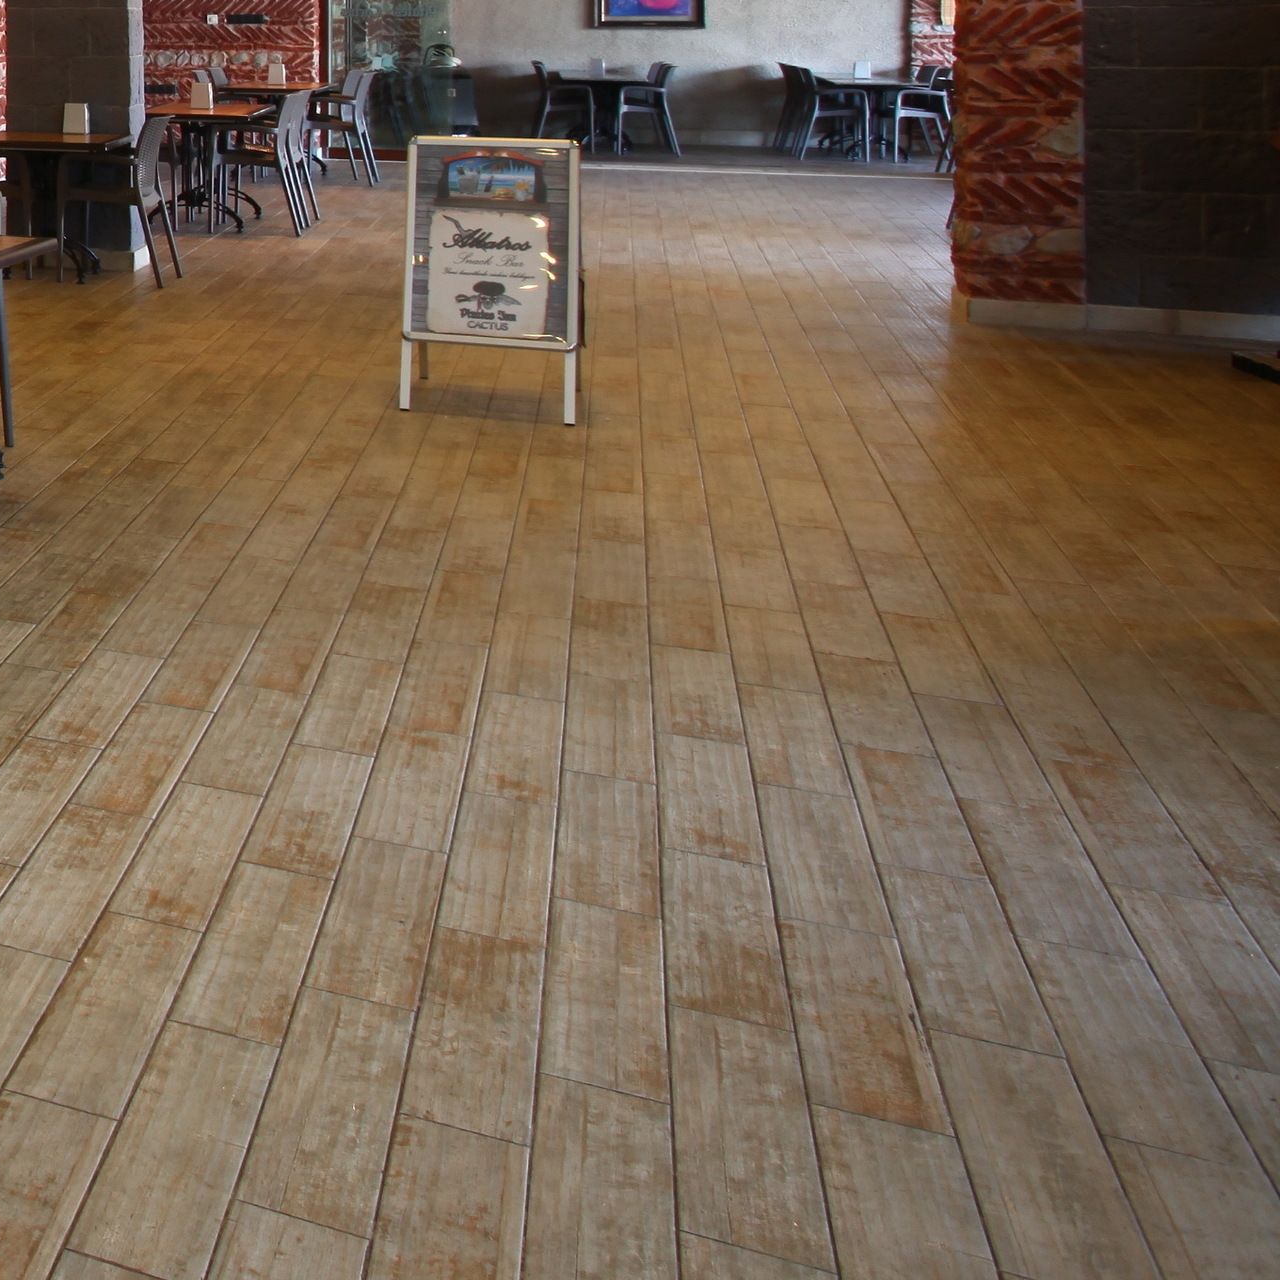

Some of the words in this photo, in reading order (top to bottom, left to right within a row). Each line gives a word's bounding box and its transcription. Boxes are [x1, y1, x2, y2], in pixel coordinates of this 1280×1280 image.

[442, 228, 532, 252] Albatros
[453, 252, 493, 267] Snack
[496, 254, 525, 268] Bar
[467, 321, 509, 332] CACTUS
